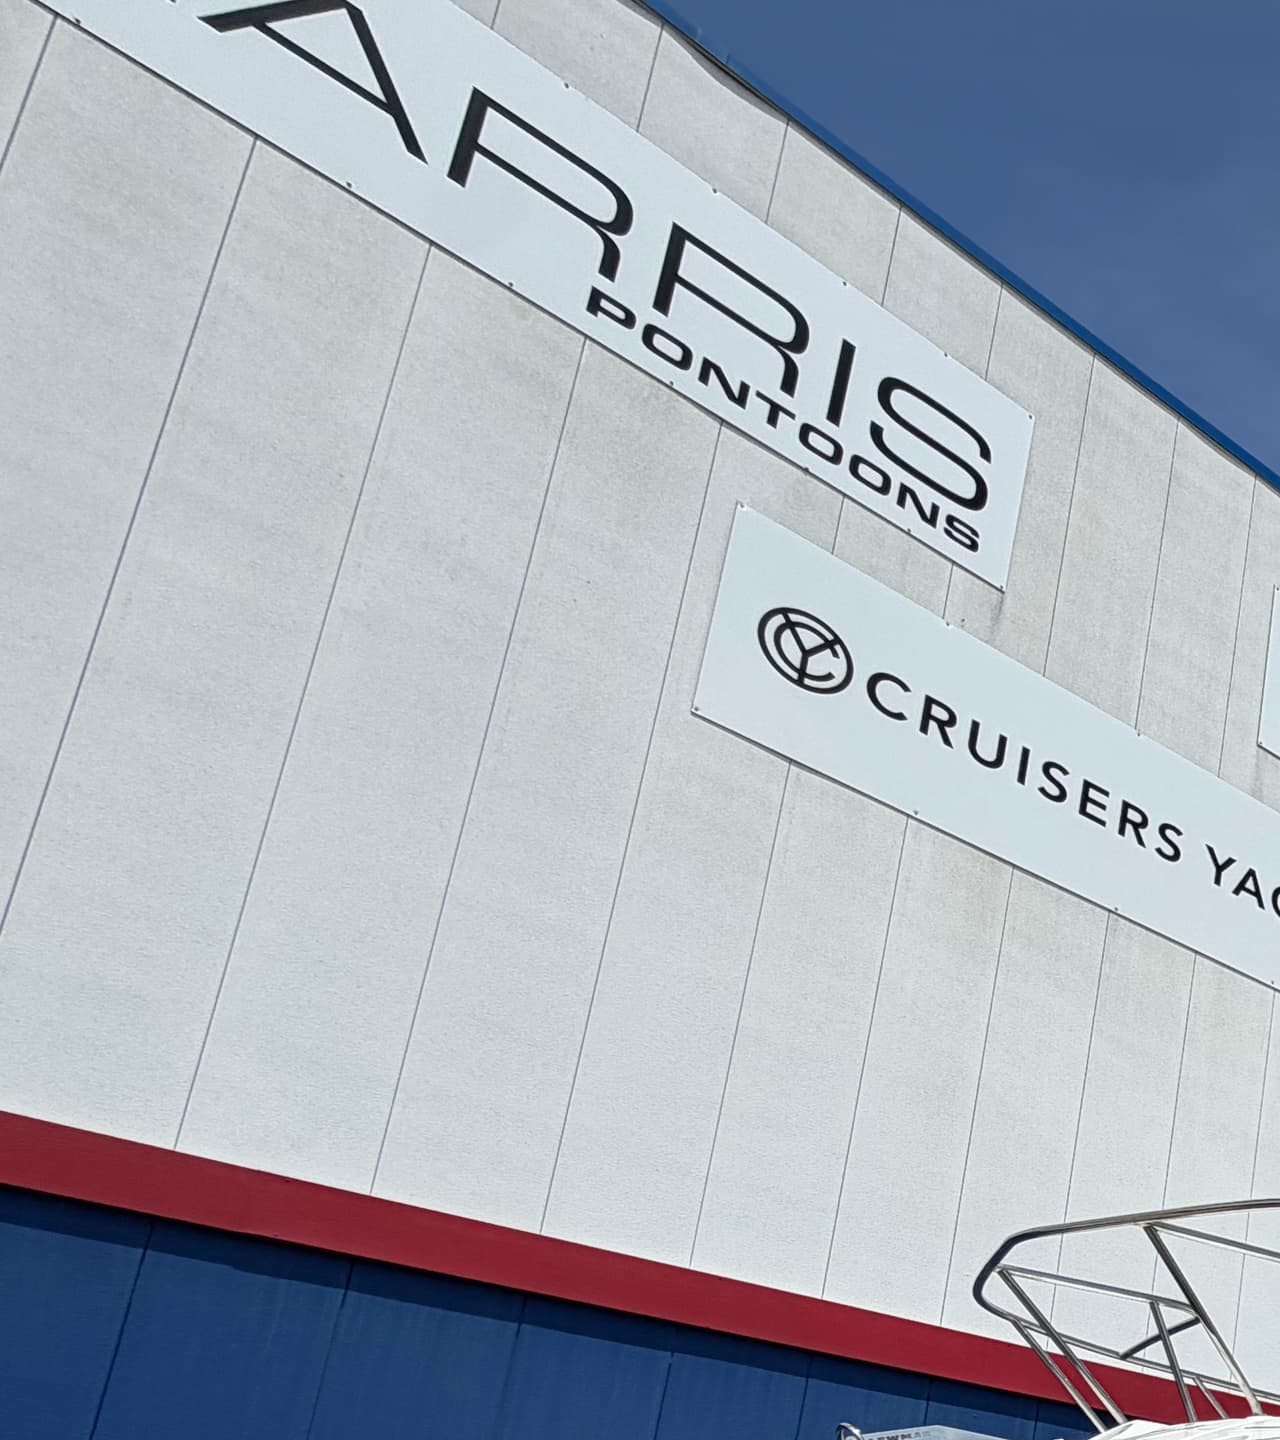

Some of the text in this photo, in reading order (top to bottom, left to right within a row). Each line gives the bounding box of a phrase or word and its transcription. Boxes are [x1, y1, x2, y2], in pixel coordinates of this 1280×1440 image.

[144, 0, 993, 512] ARRIS
[586, 285, 981, 554] PONTOONS
[866, 671, 1184, 863] CRUISERS
